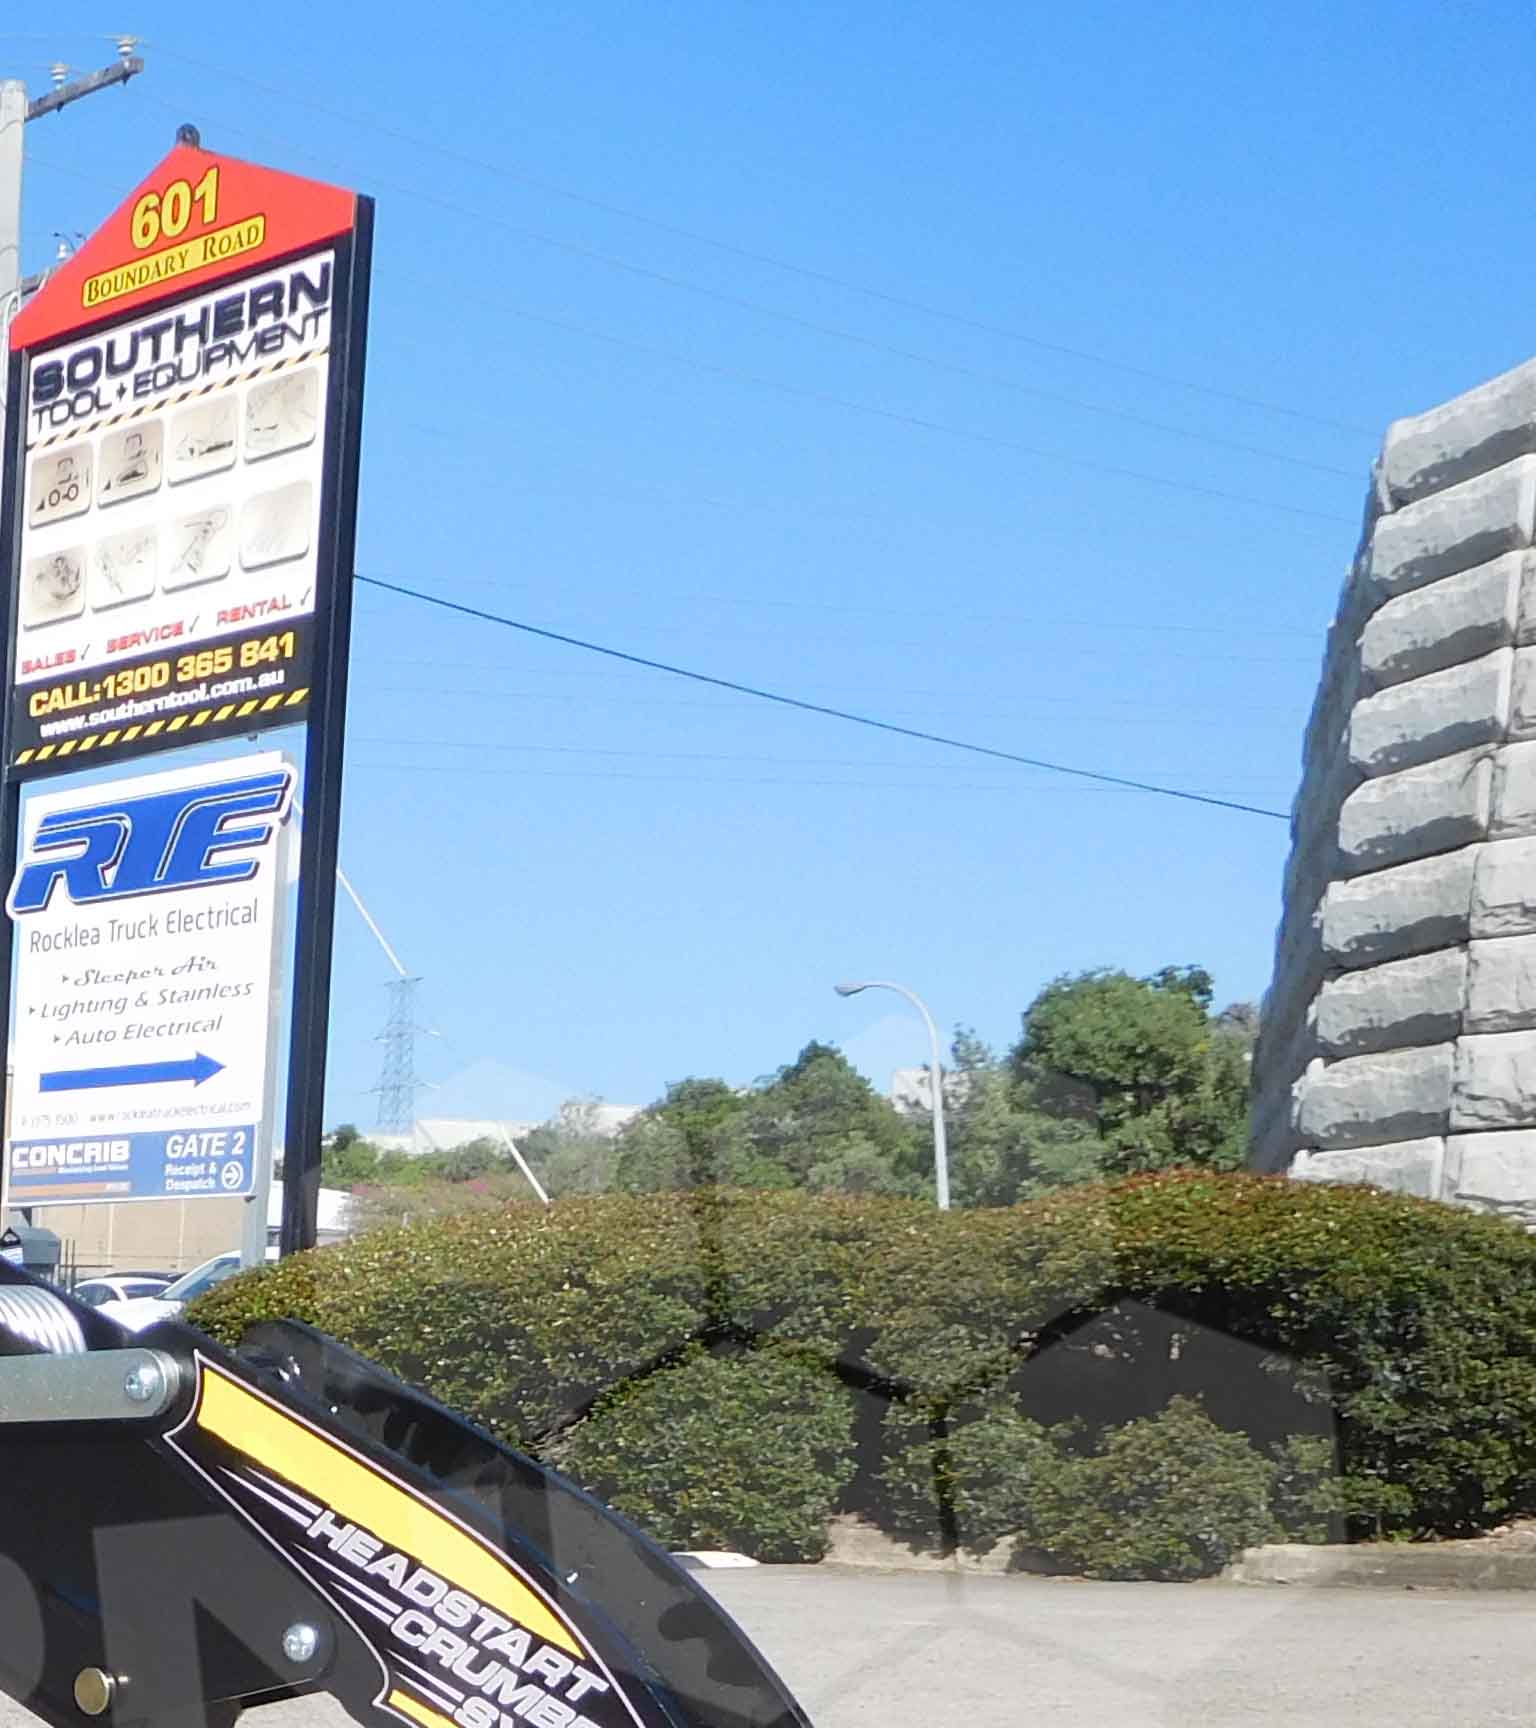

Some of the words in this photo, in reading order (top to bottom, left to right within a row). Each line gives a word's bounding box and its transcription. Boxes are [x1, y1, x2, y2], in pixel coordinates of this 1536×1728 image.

[131, 167, 219, 249] 601
[86, 250, 189, 303] BOUNDARY
[202, 223, 260, 258] ROAD
[31, 260, 332, 402] SOUTHERN
[33, 387, 113, 433] TOOL
[132, 307, 329, 399] EQUIPMENT
[21, 649, 77, 675] SALES
[105, 621, 185, 654] SERVICE
[215, 594, 292, 626] RENTAL
[176, 647, 233, 683] 365
[240, 631, 295, 666] 841
[39, 669, 286, 739] www.southerntool.com.au
[29, 925, 101, 954] Rocklea
[109, 914, 159, 945] Truck
[165, 899, 259, 936] Electrical
[39, 991, 129, 1022] Lighting
[134, 990, 150, 1009] &
[158, 980, 255, 1007] Stainless
[73, 964, 165, 989] Sleeper
[64, 1026, 117, 1048] Auto
[123, 1015, 225, 1042] Electrical
[165, 1132, 228, 1159] GATE
[231, 1130, 247, 1155] 2
[306, 1506, 610, 1702] HEADSTART
